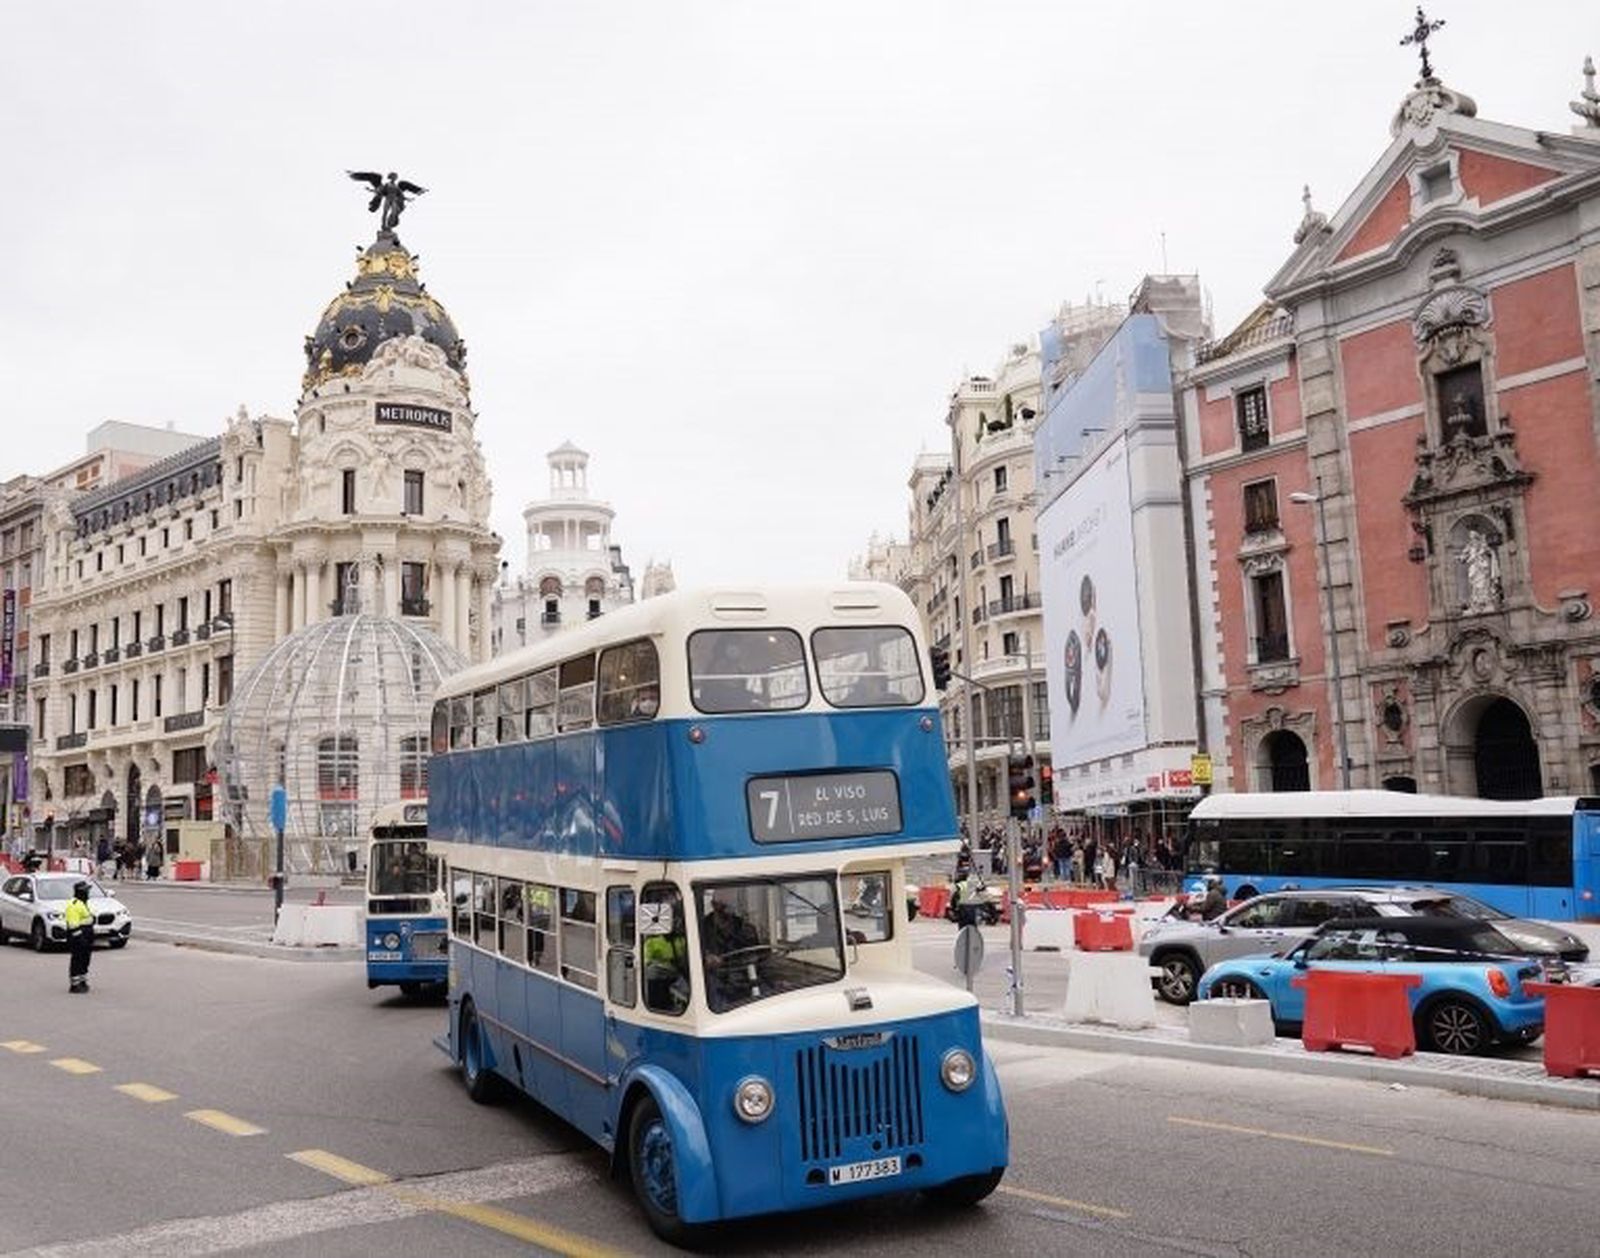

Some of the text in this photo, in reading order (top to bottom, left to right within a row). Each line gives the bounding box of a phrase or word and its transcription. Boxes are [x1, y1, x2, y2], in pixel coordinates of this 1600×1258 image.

[380, 407, 449, 427] METROPOLIS
[816, 786, 866, 800] EL VISO
[760, 791, 779, 829] 7
[826, 810, 842, 824] DE
[862, 807, 888, 821] LUIS
